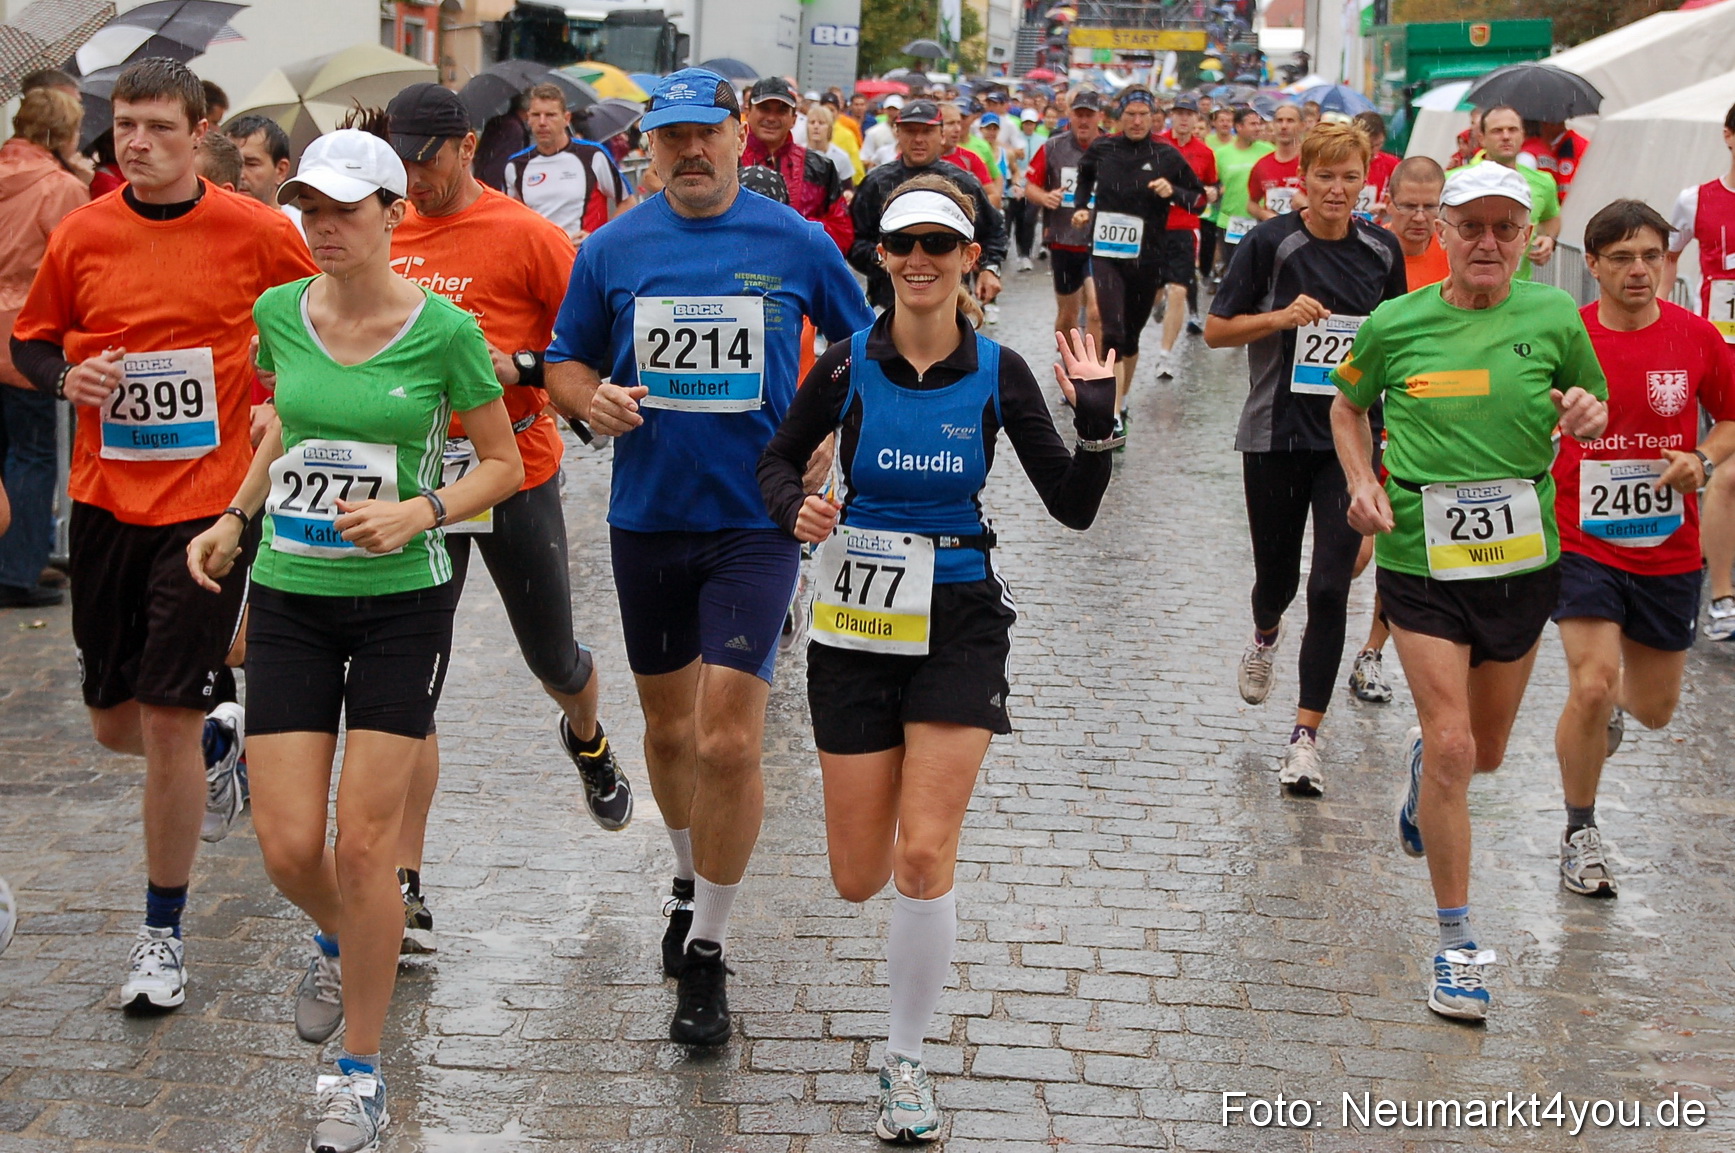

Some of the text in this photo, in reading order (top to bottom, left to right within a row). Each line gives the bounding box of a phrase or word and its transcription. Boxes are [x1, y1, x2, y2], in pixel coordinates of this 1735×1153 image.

[1113, 34, 1160, 46] START
[1099, 225, 1137, 242] 3070
[673, 304, 723, 316] BOCK
[647, 327, 752, 370] 2214
[125, 358, 172, 371] BOCK
[669, 379, 730, 396] Norbert
[110, 378, 204, 422] 2399
[131, 430, 179, 448] Eugen
[303, 447, 352, 461] BOCK
[877, 448, 964, 473] Claudia
[279, 471, 383, 515] 2277
[1457, 486, 1502, 498] BOCK
[1590, 482, 1674, 516] 2469
[1446, 503, 1514, 541] 231
[1606, 522, 1659, 536] Gerhard
[304, 523, 352, 544] Katr
[1468, 546, 1505, 563] Willi
[834, 560, 906, 608] 477
[835, 611, 893, 636] Claudia
